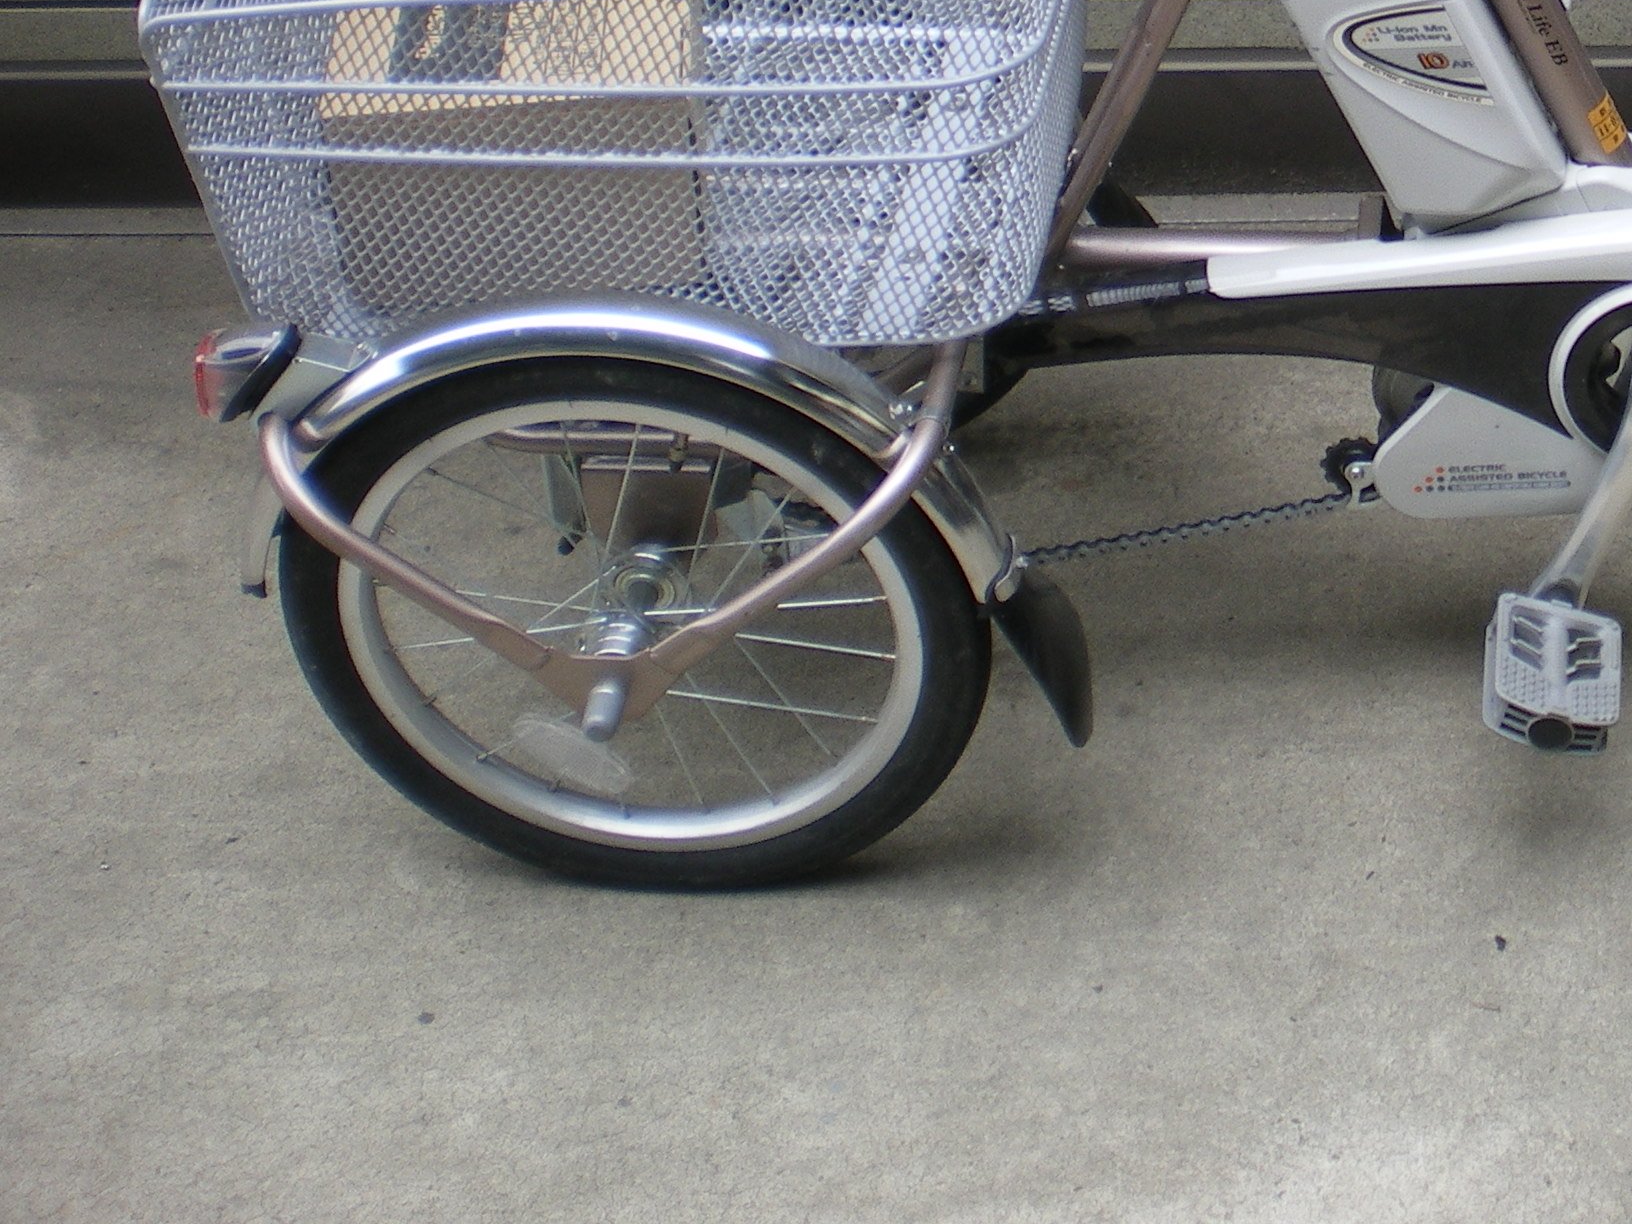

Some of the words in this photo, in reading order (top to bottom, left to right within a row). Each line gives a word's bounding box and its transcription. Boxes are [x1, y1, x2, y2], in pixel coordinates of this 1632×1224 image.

[1393, 32, 1453, 43] Battery
[1526, 3, 1553, 37] Life
[1545, 39, 1569, 66] EB
[1417, 52, 1450, 70] 10
[1448, 463, 1505, 474] ELECTRIC
[1449, 473, 1513, 483] ASSISTED
[1517, 470, 1568, 481] BICYCLE
